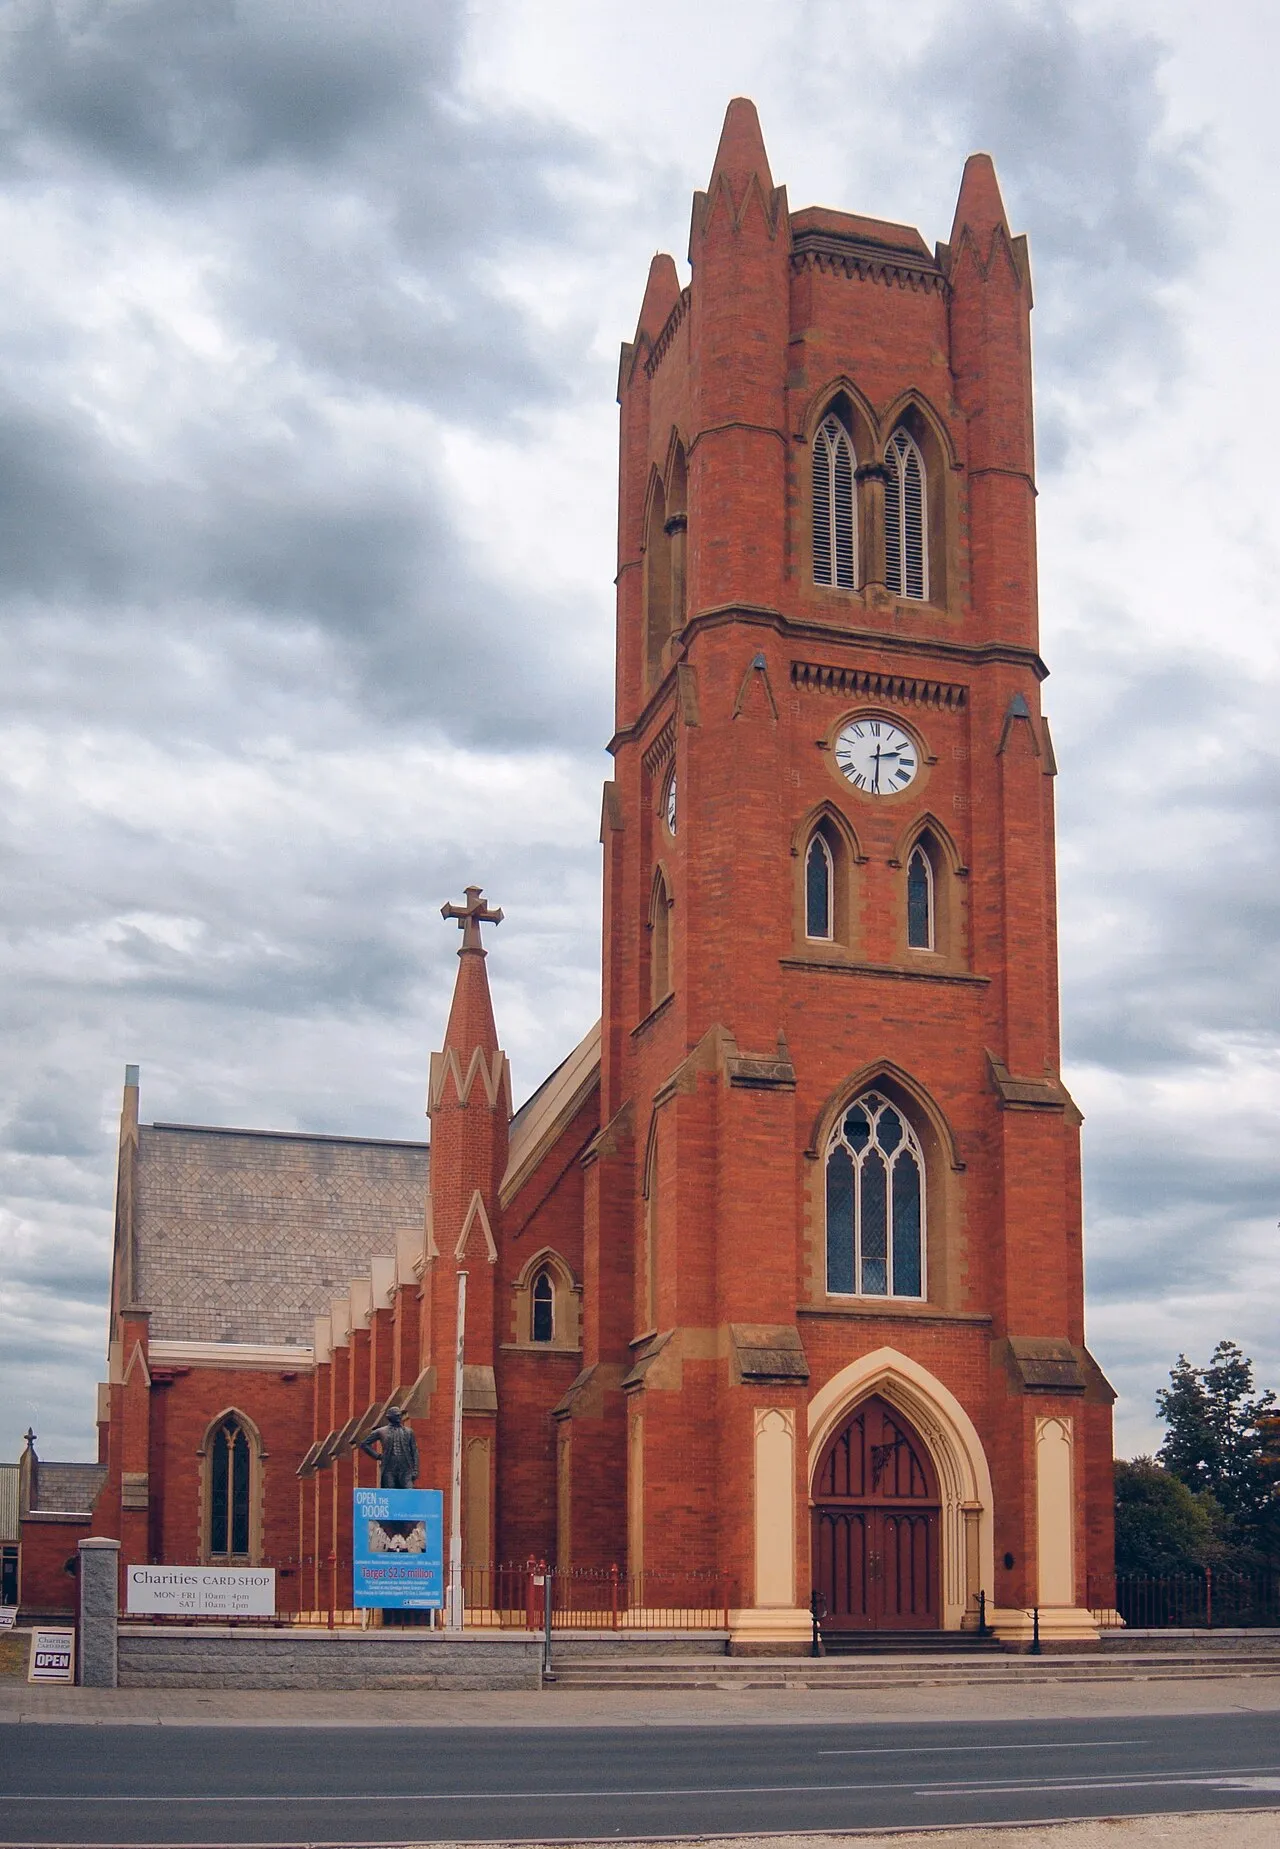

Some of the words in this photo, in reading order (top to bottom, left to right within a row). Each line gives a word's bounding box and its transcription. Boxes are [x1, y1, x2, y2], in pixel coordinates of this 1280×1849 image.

[869, 721, 881, 737] XII
[895, 742, 910, 751] II
[899, 758, 915, 767] III
[356, 1492, 376, 1504] OPEN
[362, 1506, 389, 1518] DOORS
[133, 1572, 198, 1585] Charities
[203, 1576, 236, 1586] CARD
[238, 1577, 270, 1586] SHOP
[362, 1567, 387, 1580] Target
[388, 1567, 406, 1578] $2.5
[408, 1568, 434, 1578] million
[205, 1592, 226, 1600] 10am
[232, 1593, 250, 1601] 4pm
[232, 1602, 249, 1610] 1pm
[37, 1654, 69, 1667] OPEN
